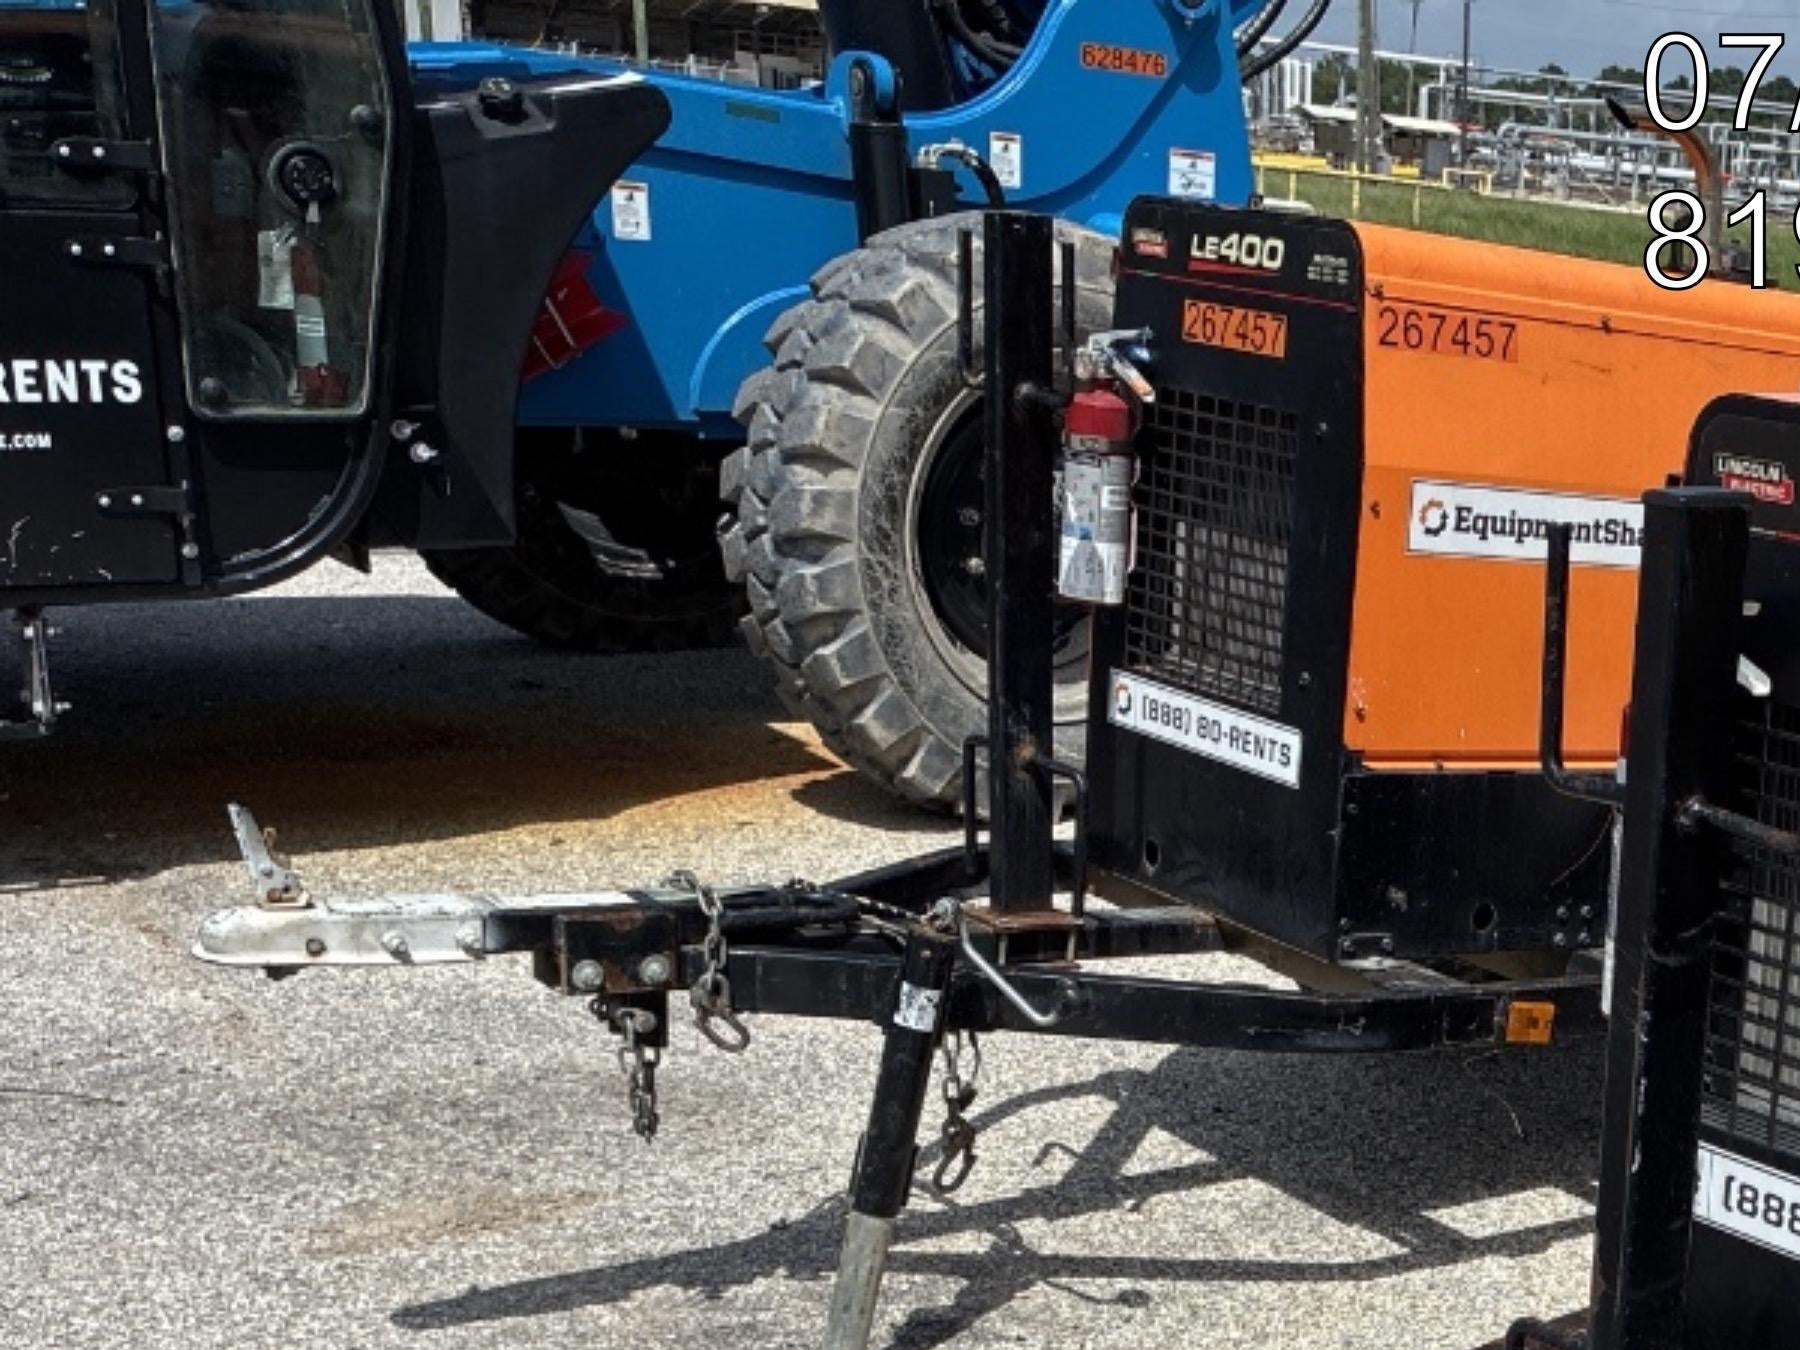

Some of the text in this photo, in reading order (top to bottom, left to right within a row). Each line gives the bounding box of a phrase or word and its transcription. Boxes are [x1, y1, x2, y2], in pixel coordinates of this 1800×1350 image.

[1082, 44, 1165, 76] 628476
[1190, 233, 1286, 270] LE400
[1185, 302, 1286, 353] 267457
[1378, 305, 1517, 361] 267457
[1141, 694, 1291, 768] (888) 80-RENTS
